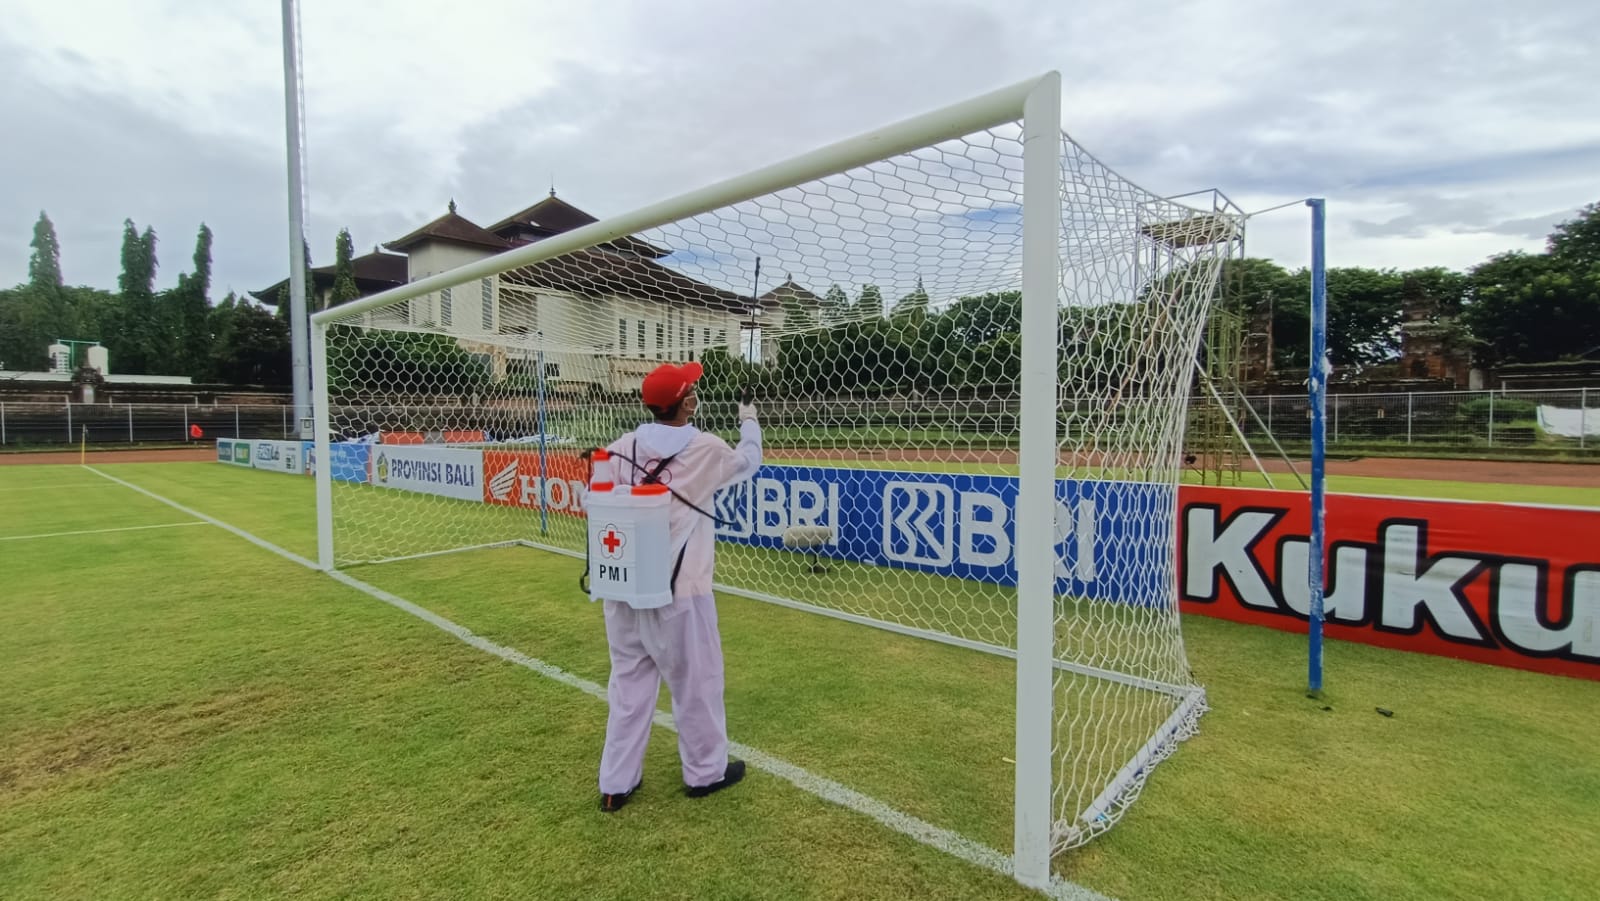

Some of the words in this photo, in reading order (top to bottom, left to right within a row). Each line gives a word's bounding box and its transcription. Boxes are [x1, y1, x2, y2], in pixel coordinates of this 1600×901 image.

[391, 458, 441, 482] PROVINSI
[445, 463, 475, 487] BALI
[756, 477, 839, 547] BRI
[599, 564, 628, 583] PMI
[1182, 503, 1600, 663] Kuku
